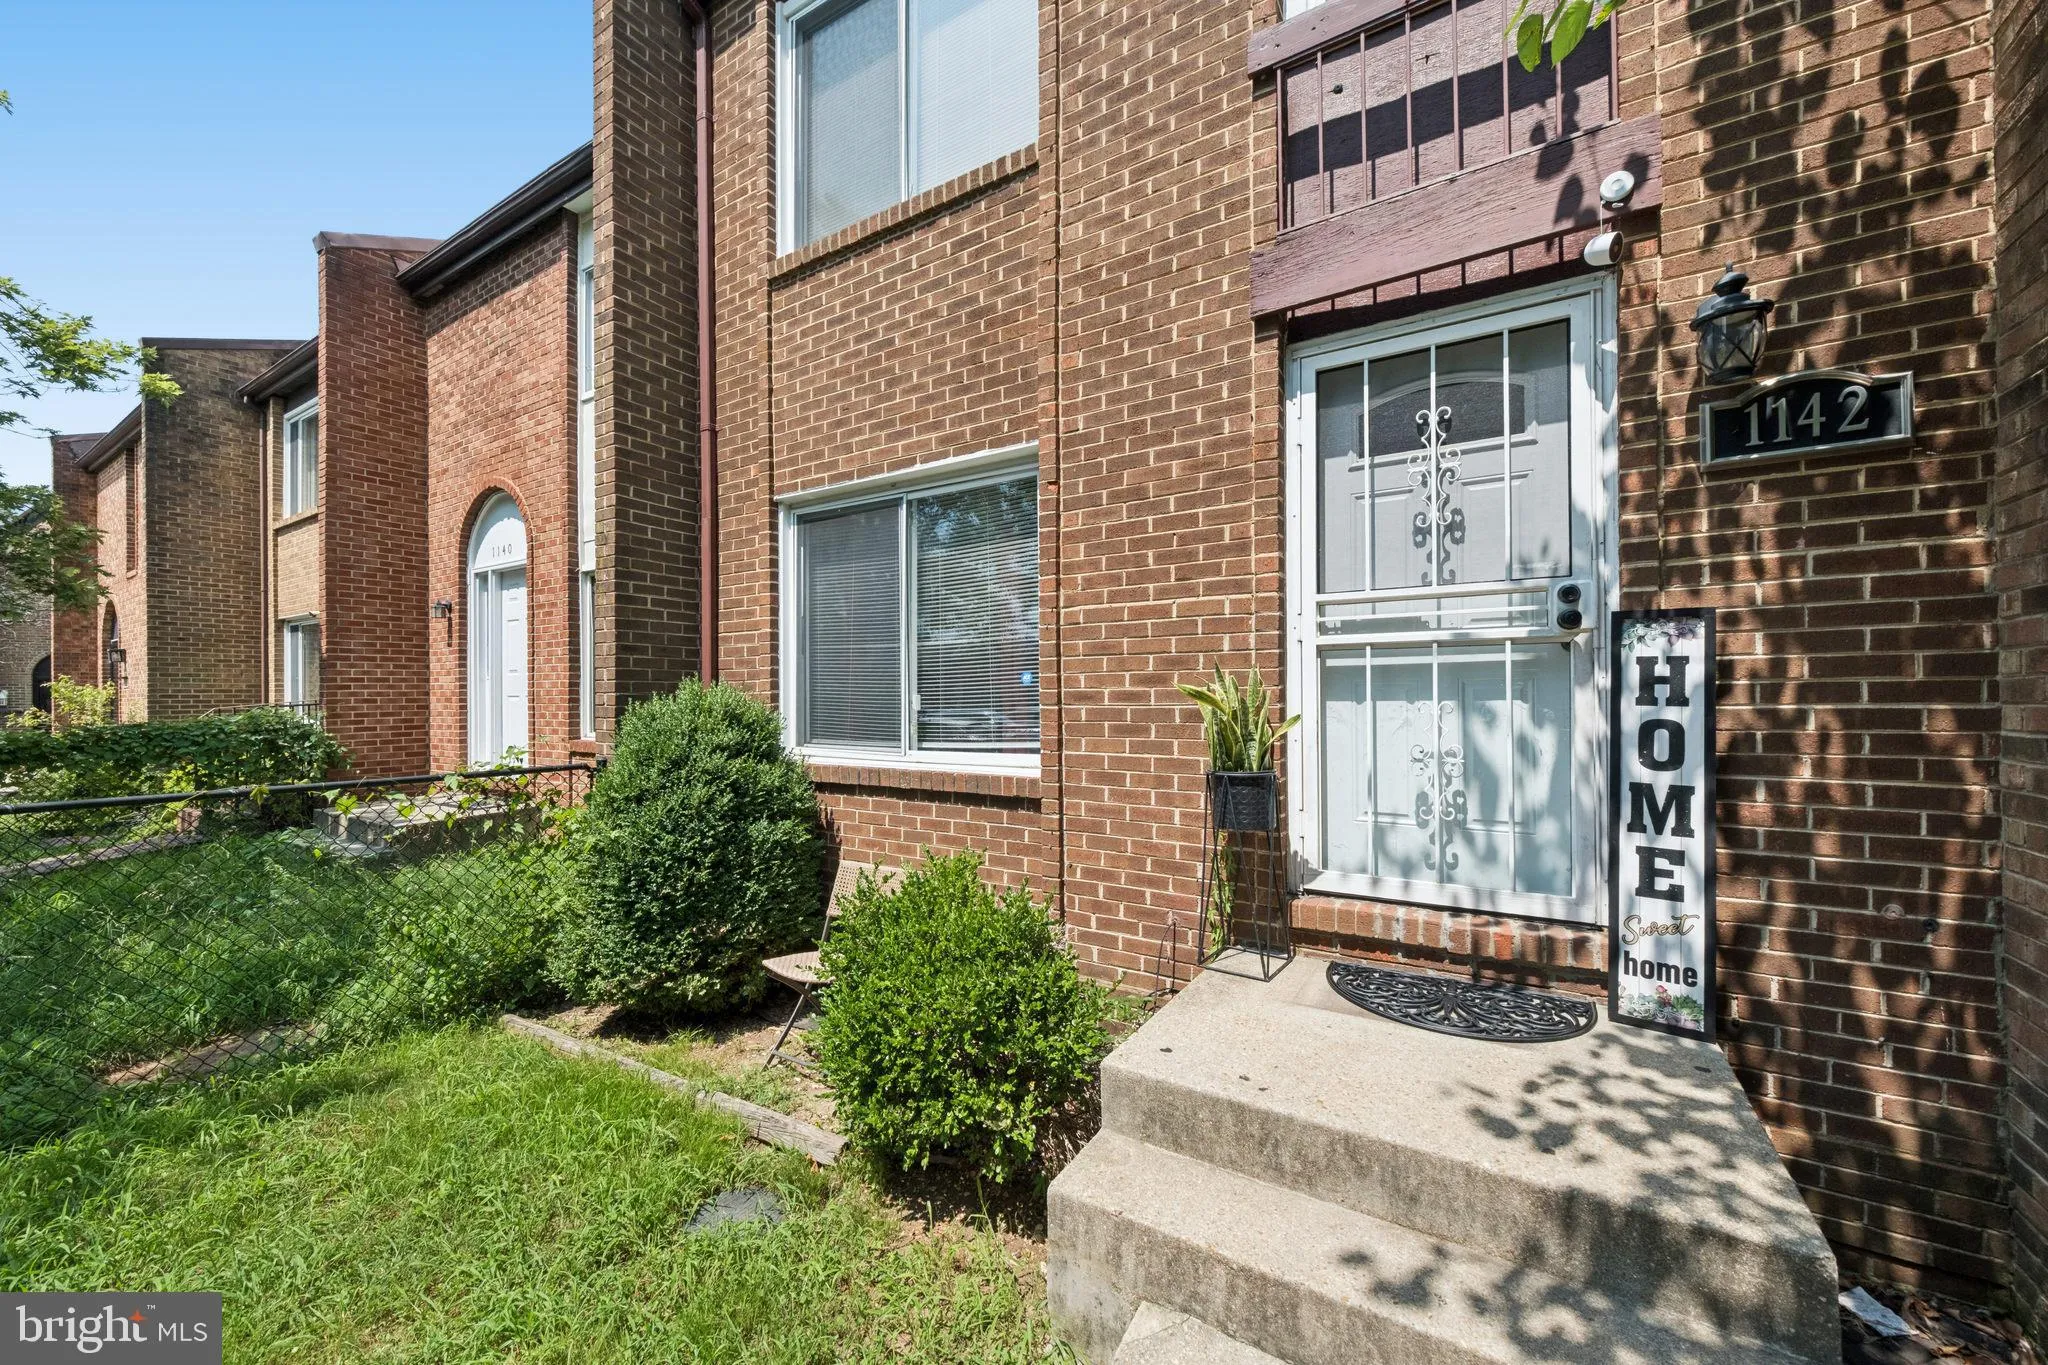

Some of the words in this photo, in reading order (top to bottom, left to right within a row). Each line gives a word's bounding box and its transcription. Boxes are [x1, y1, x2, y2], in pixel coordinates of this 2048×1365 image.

[1743, 385, 1870, 447] 1142
[492, 543, 513, 558] 1140
[1626, 655, 1696, 903] HOME
[1621, 913, 1700, 946] Sweet
[1623, 949, 1698, 988] home
